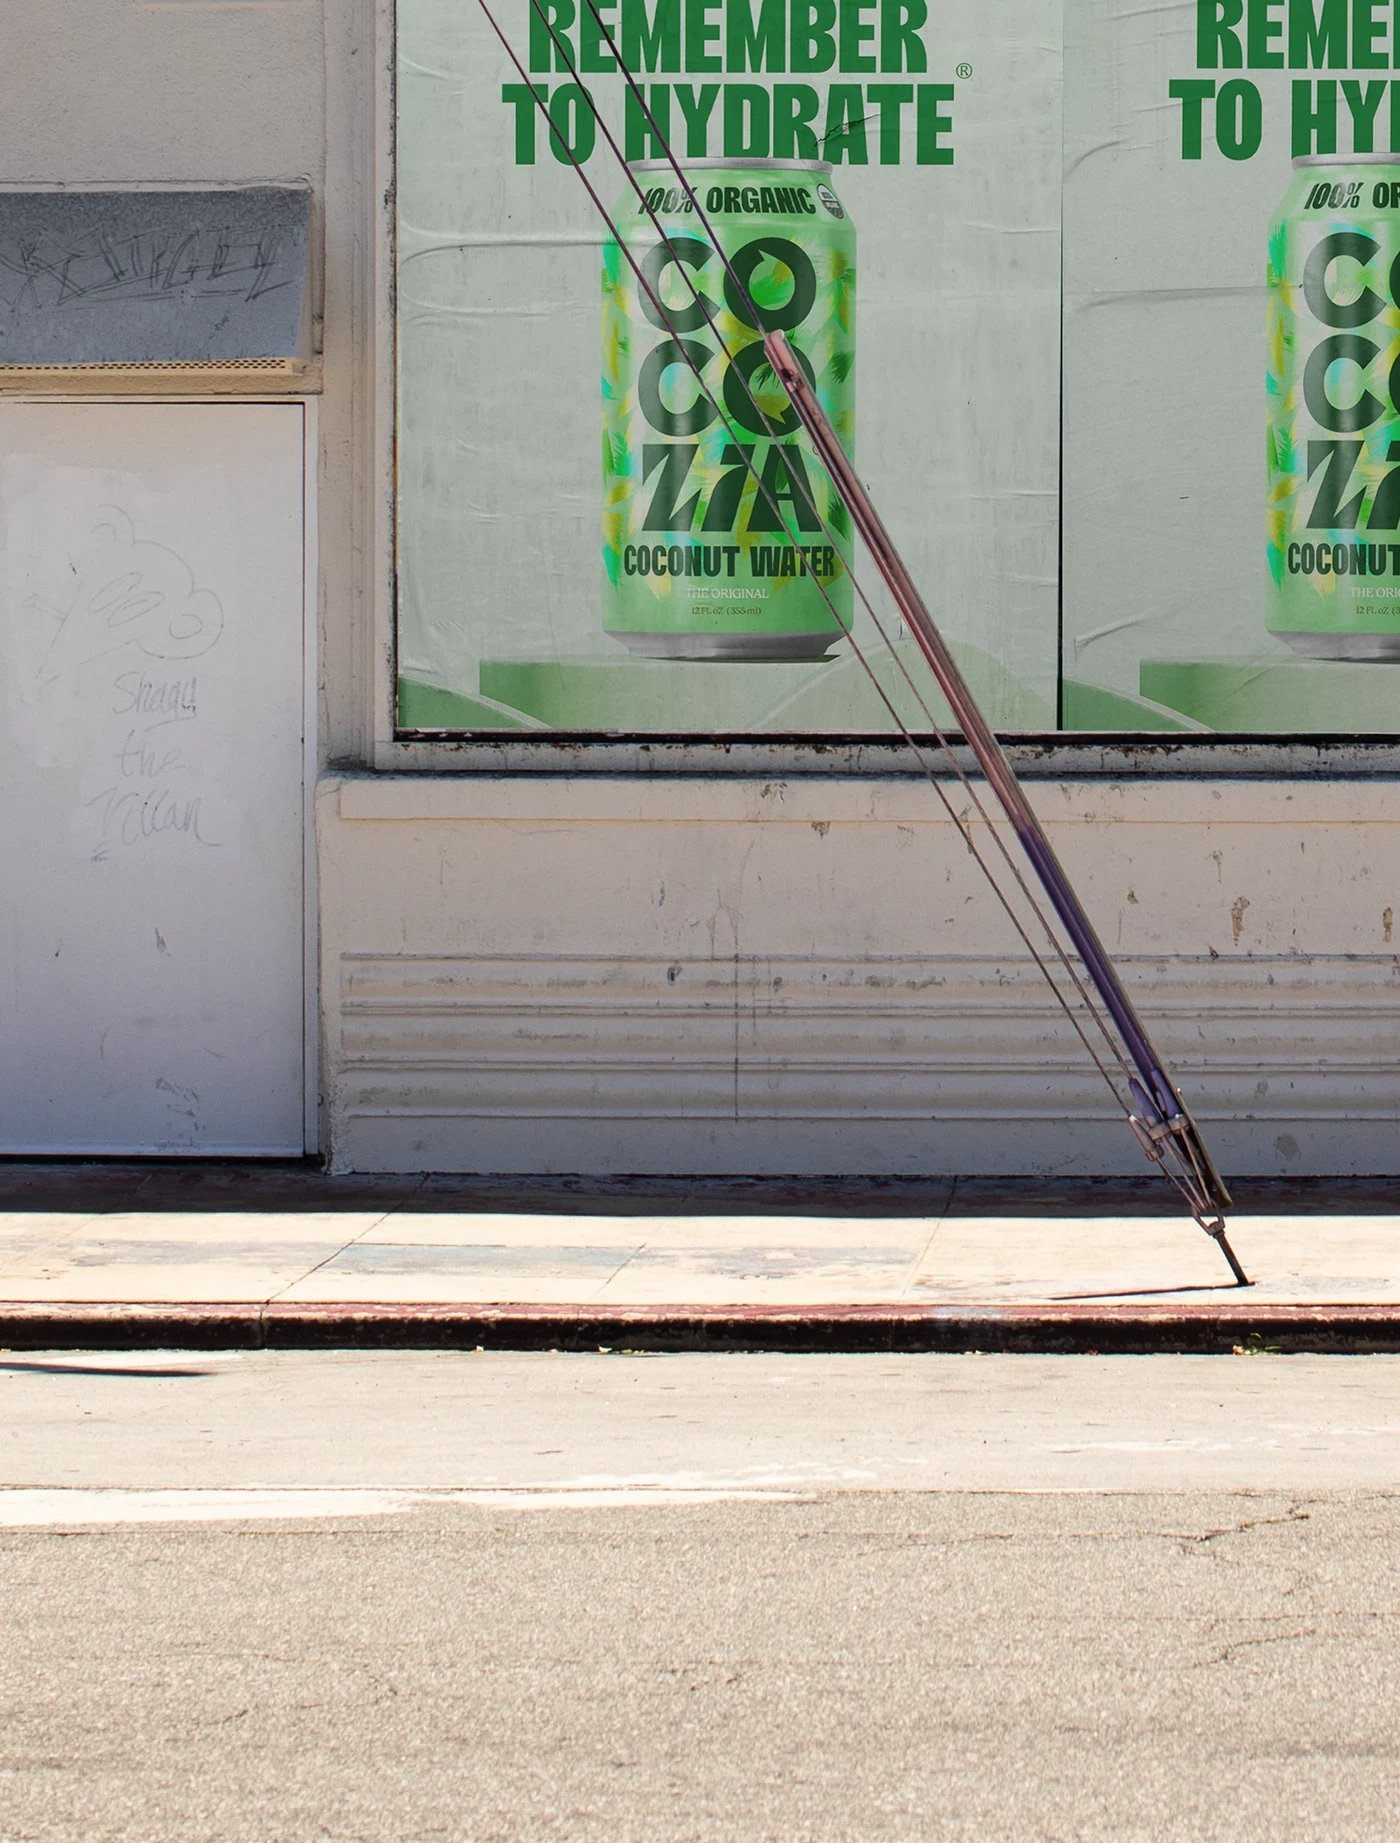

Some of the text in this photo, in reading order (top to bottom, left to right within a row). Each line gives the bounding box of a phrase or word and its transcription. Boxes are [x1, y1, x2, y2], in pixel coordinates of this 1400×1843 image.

[502, 83, 596, 165] TO
[624, 83, 955, 165] HYDRATE
[1169, 80, 1262, 161] TO
[638, 187, 698, 214] 100%
[706, 187, 816, 214] ORGANIC
[1305, 182, 1363, 210] 100%
[638, 236, 815, 334] CO
[638, 340, 815, 438] CO
[624, 544, 835, 577] COCONUT WATER
[685, 588, 770, 599] THE ORIGINAL
[1350, 587, 1374, 598] THE
[113, 729, 185, 777] the
